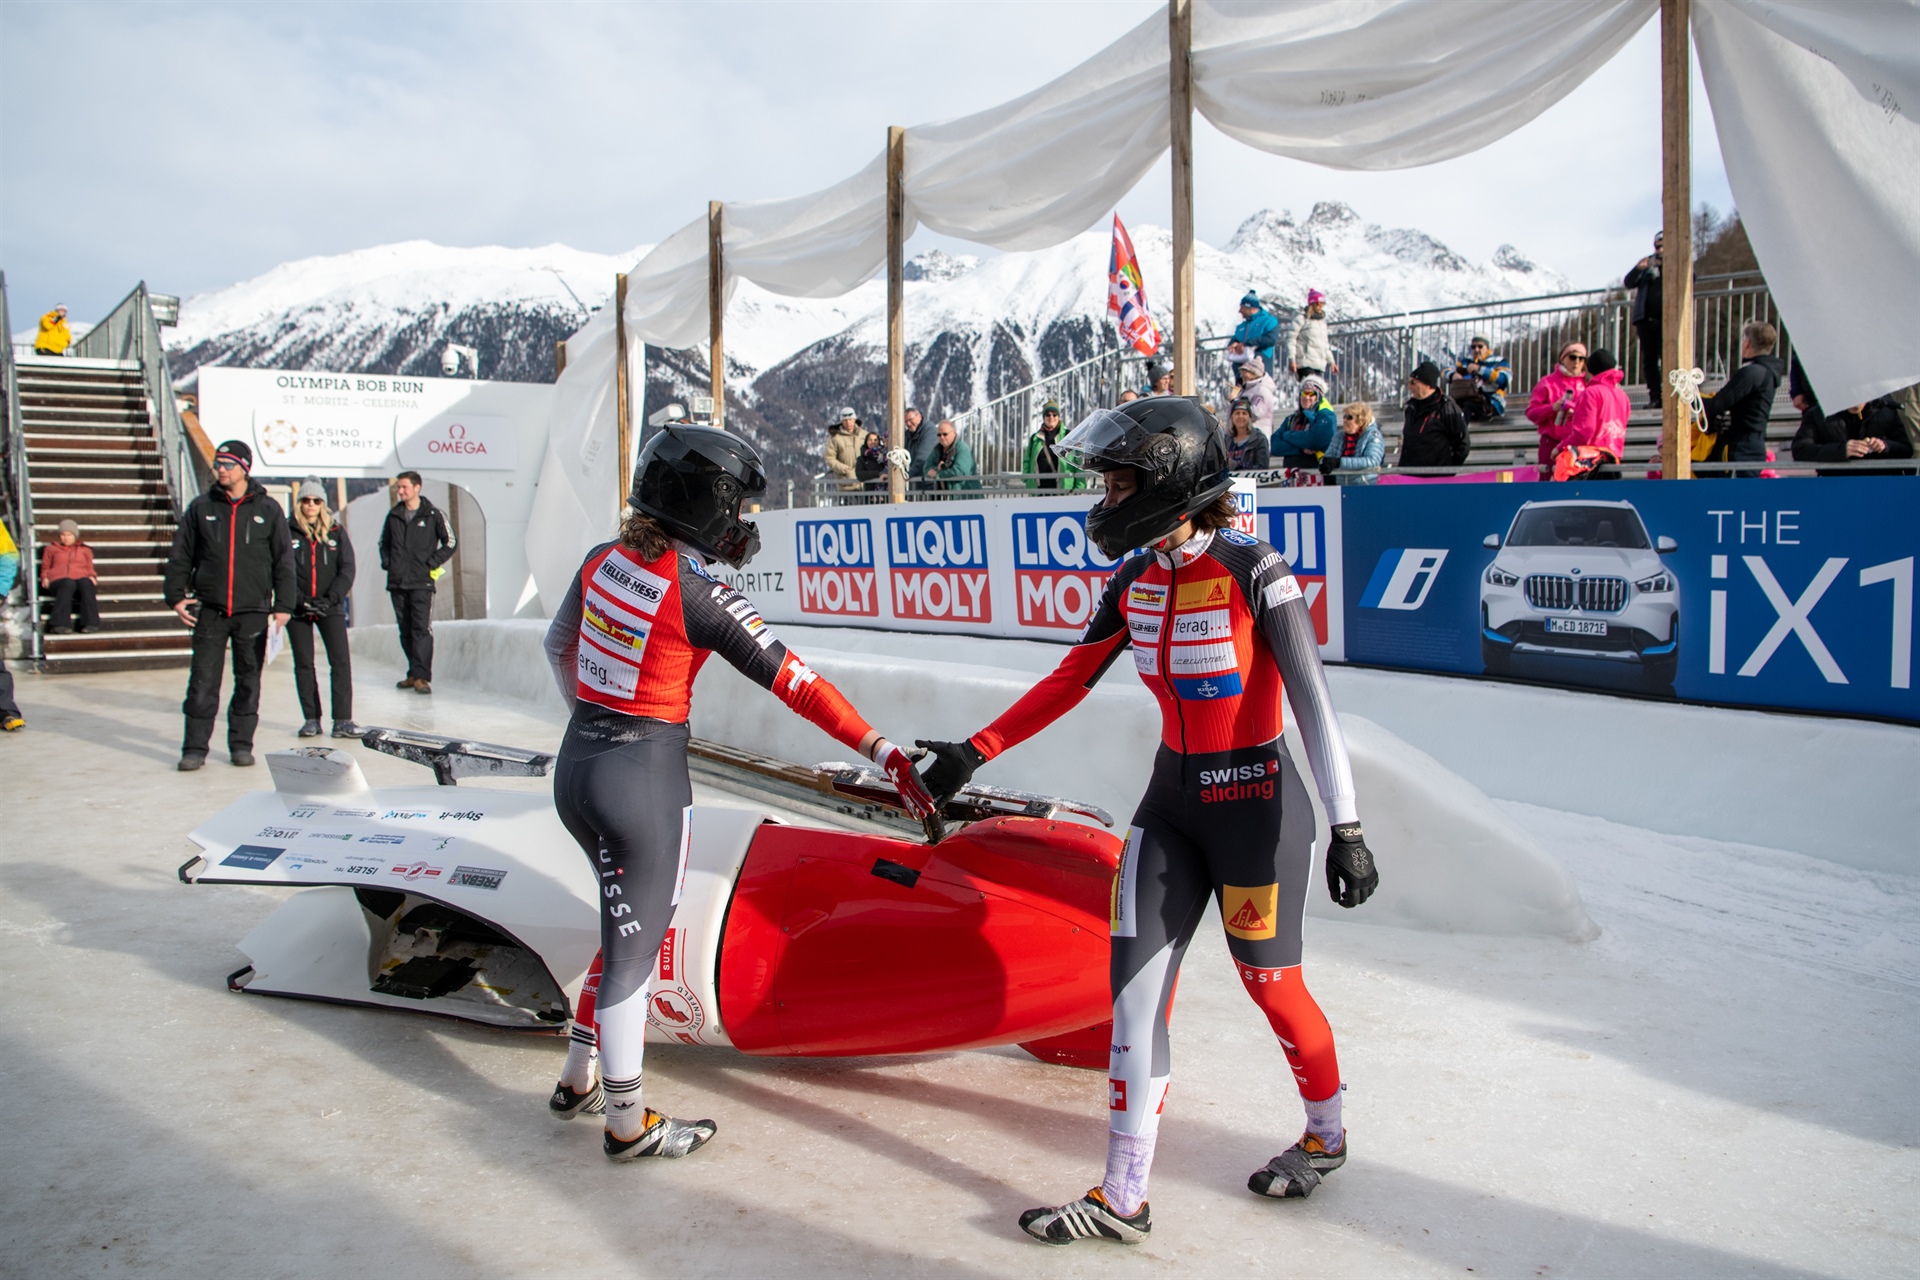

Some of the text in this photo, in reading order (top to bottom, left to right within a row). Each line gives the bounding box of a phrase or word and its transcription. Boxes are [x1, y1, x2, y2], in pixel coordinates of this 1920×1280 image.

[277, 376, 424, 393] OLYMPIA BOB RUN
[304, 396, 349, 406] MORITZ
[363, 398, 419, 409] CELERINA
[306, 427, 360, 437] CASINO
[306, 439, 383, 449] ST. MORITZ
[428, 441, 488, 454] OMEGA
[1707, 510, 1800, 545] THE
[798, 522, 871, 567] LIQUI
[889, 519, 984, 568] LIQUI
[1224, 531, 1249, 545] Ford
[725, 572, 784, 592] MORITZ
[800, 570, 875, 613] MOLY
[894, 571, 988, 618] MOLY
[1709, 555, 1914, 689] iX1
[439, 811, 484, 821] Style-it
[347, 865, 379, 875] ISLER
[461, 872, 501, 889] FREBA
[1231, 908, 1261, 928] Sika
[662, 936, 672, 971] SUIZA
[677, 986, 702, 1031] FRAUENFELD
